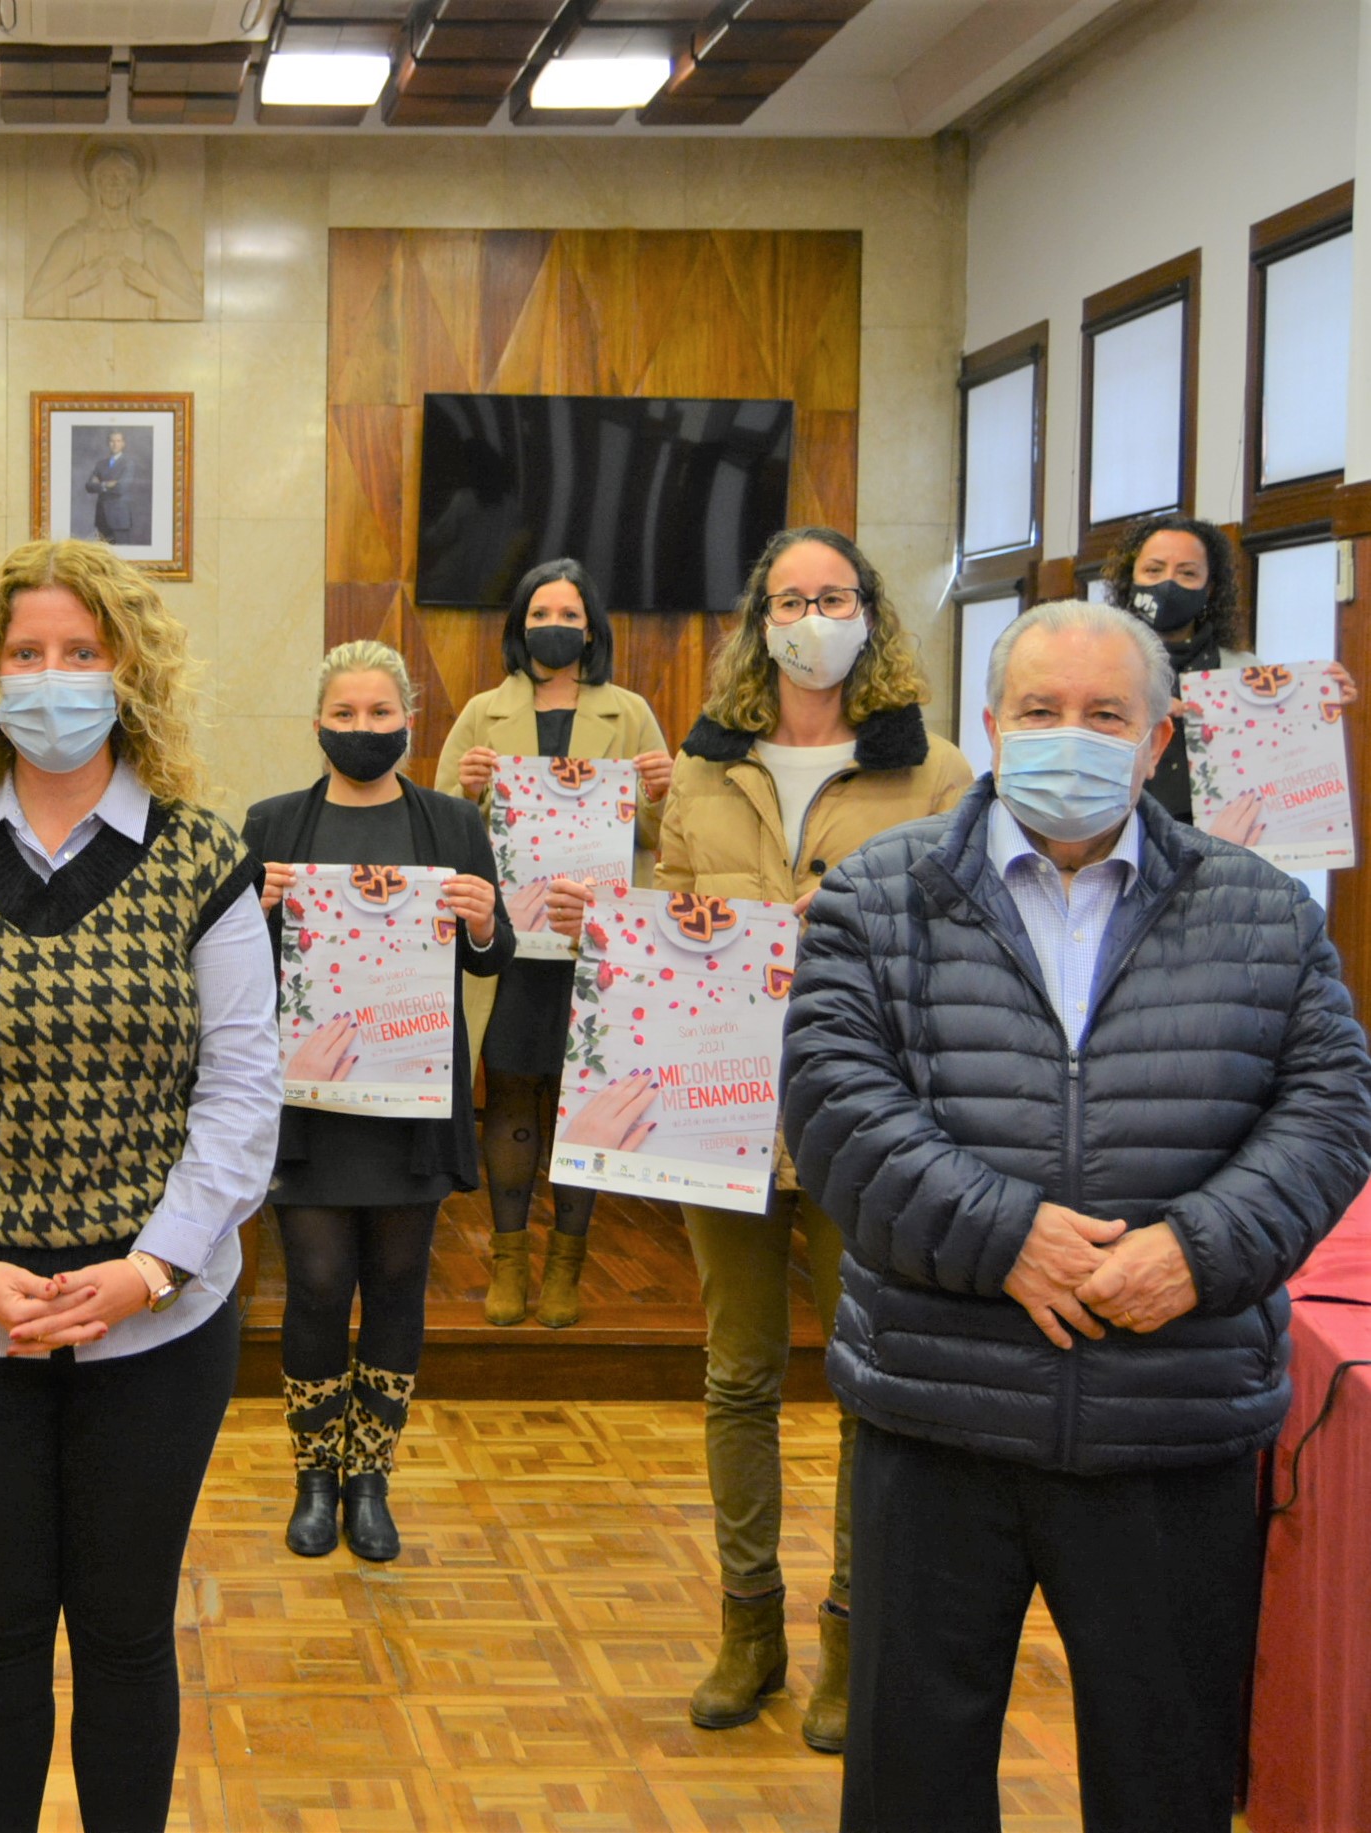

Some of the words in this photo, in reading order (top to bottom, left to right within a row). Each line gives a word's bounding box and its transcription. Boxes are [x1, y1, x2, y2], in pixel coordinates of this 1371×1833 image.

[678, 1026, 697, 1038] San
[700, 1021, 738, 1036] Valentín
[697, 1040, 725, 1055] 2021
